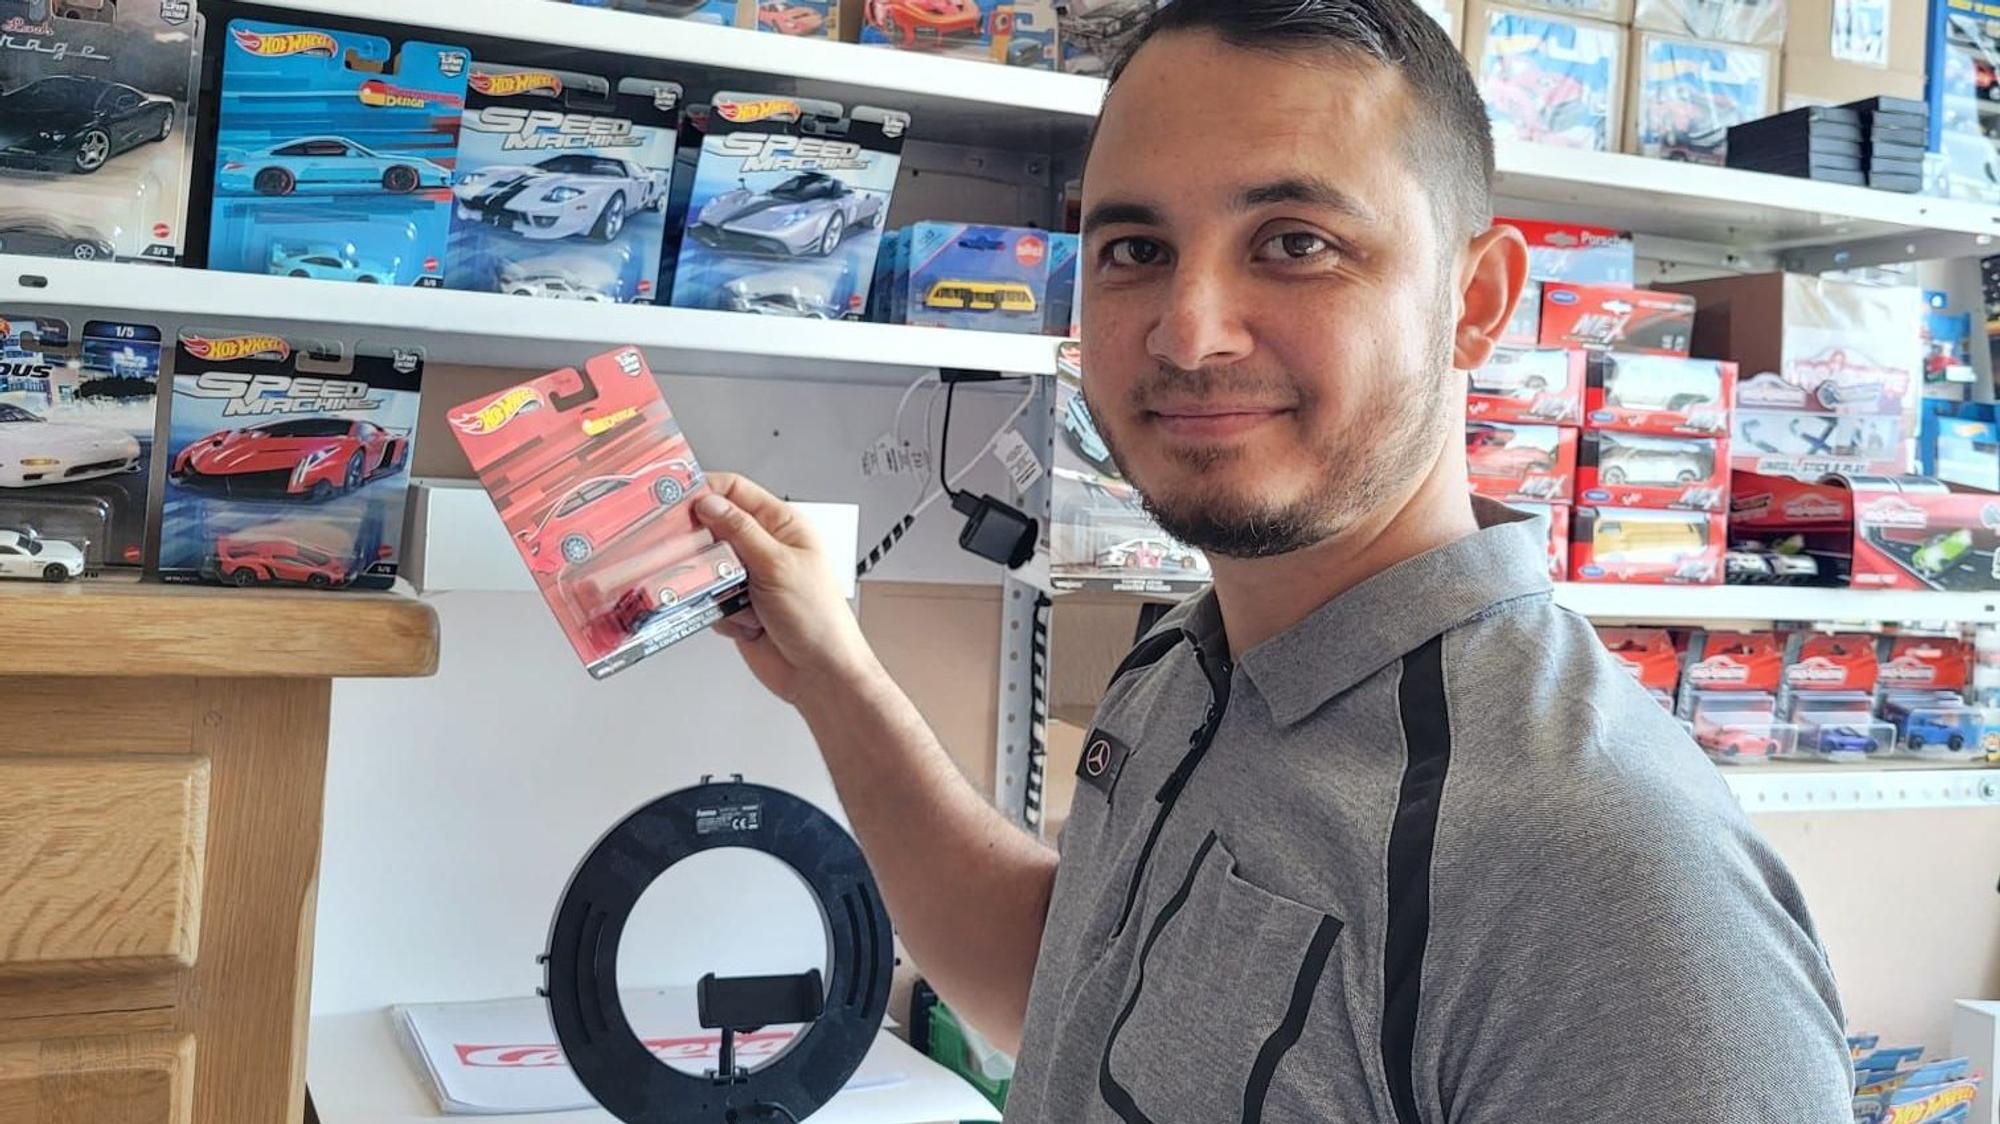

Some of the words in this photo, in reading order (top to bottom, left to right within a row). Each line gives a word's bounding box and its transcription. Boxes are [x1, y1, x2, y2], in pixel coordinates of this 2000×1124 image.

[260, 35, 289, 54] HOT
[491, 75, 517, 94] HOT
[480, 106, 633, 136] SPEED
[502, 132, 648, 151] MACHINES
[723, 131, 861, 158] SPEED
[740, 156, 871, 173] MACHINES
[115, 325, 135, 338] 1/5
[210, 339, 240, 358] HOT
[197, 371, 369, 400] SPEED
[222, 398, 386, 417] MACHINES
